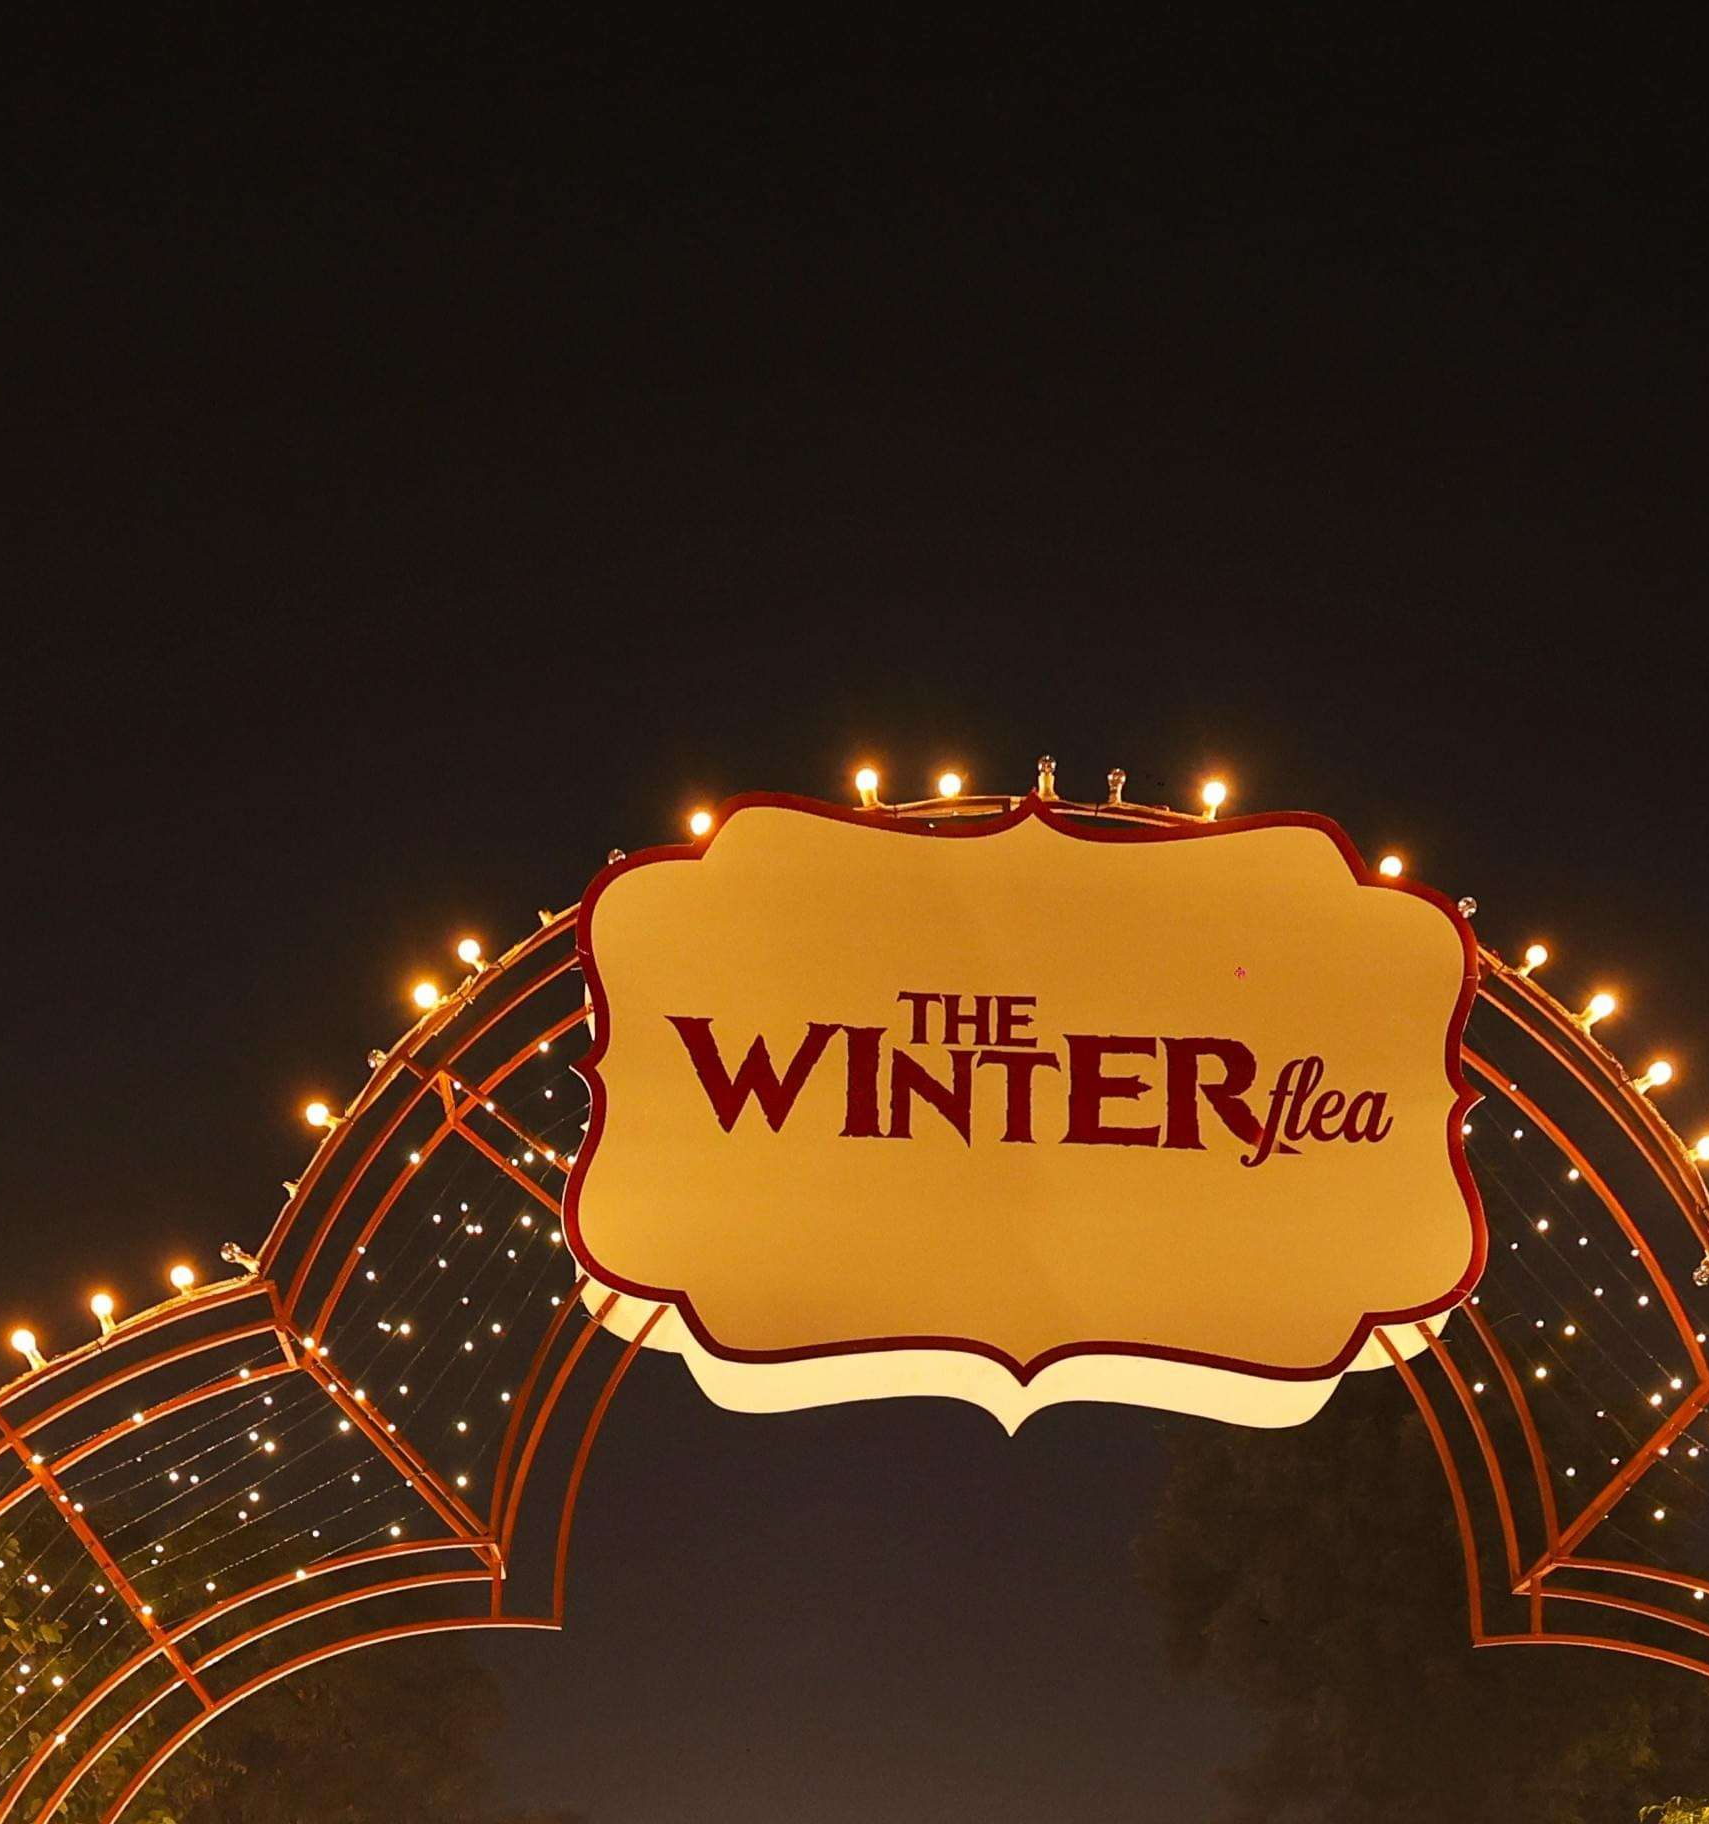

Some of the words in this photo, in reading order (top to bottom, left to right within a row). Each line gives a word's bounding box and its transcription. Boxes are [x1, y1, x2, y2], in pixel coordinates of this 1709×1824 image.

[896, 991, 1039, 1048] THE
[664, 1014, 1302, 1155] WINTER
[1241, 1055, 1394, 1167] flea
